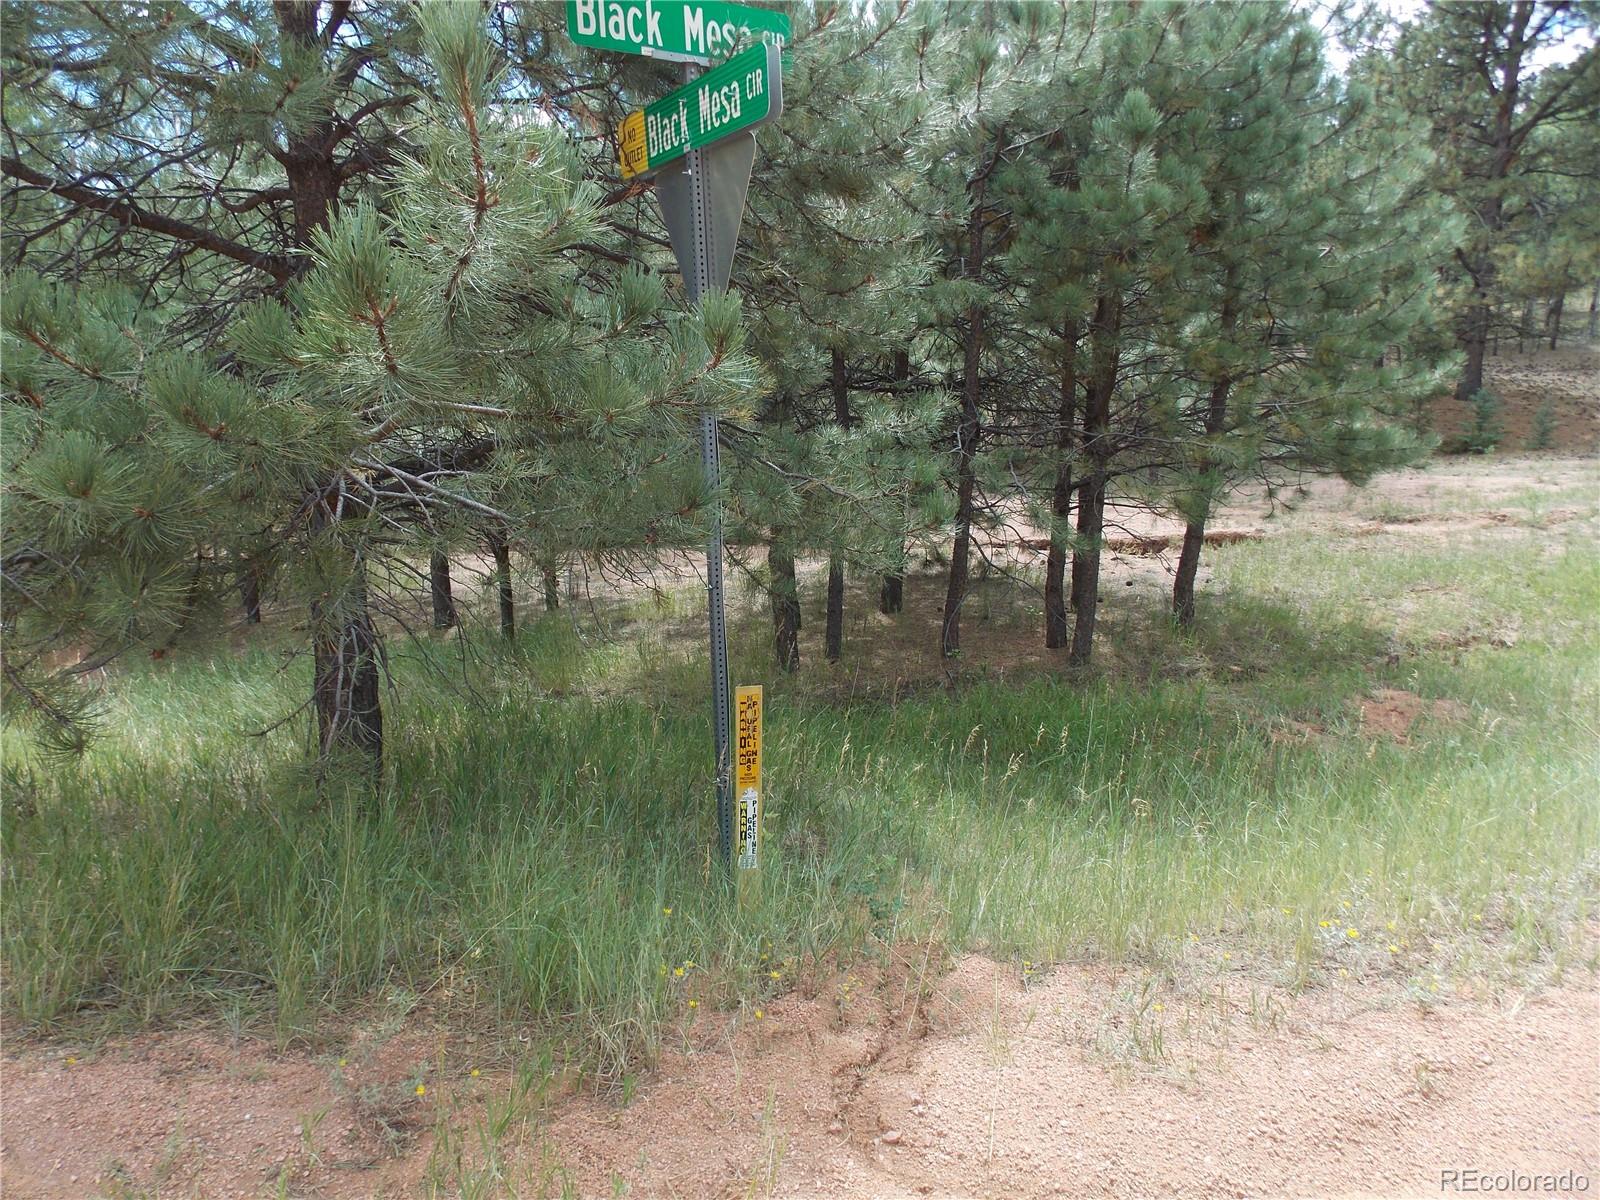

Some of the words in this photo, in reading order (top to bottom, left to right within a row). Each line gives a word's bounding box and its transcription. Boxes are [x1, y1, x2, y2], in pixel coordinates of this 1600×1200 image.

[576, 0, 663, 47] Black
[627, 127, 637, 144] NO
[647, 101, 689, 158] Black
[698, 80, 741, 135] Mesa
[746, 68, 763, 101] CIR
